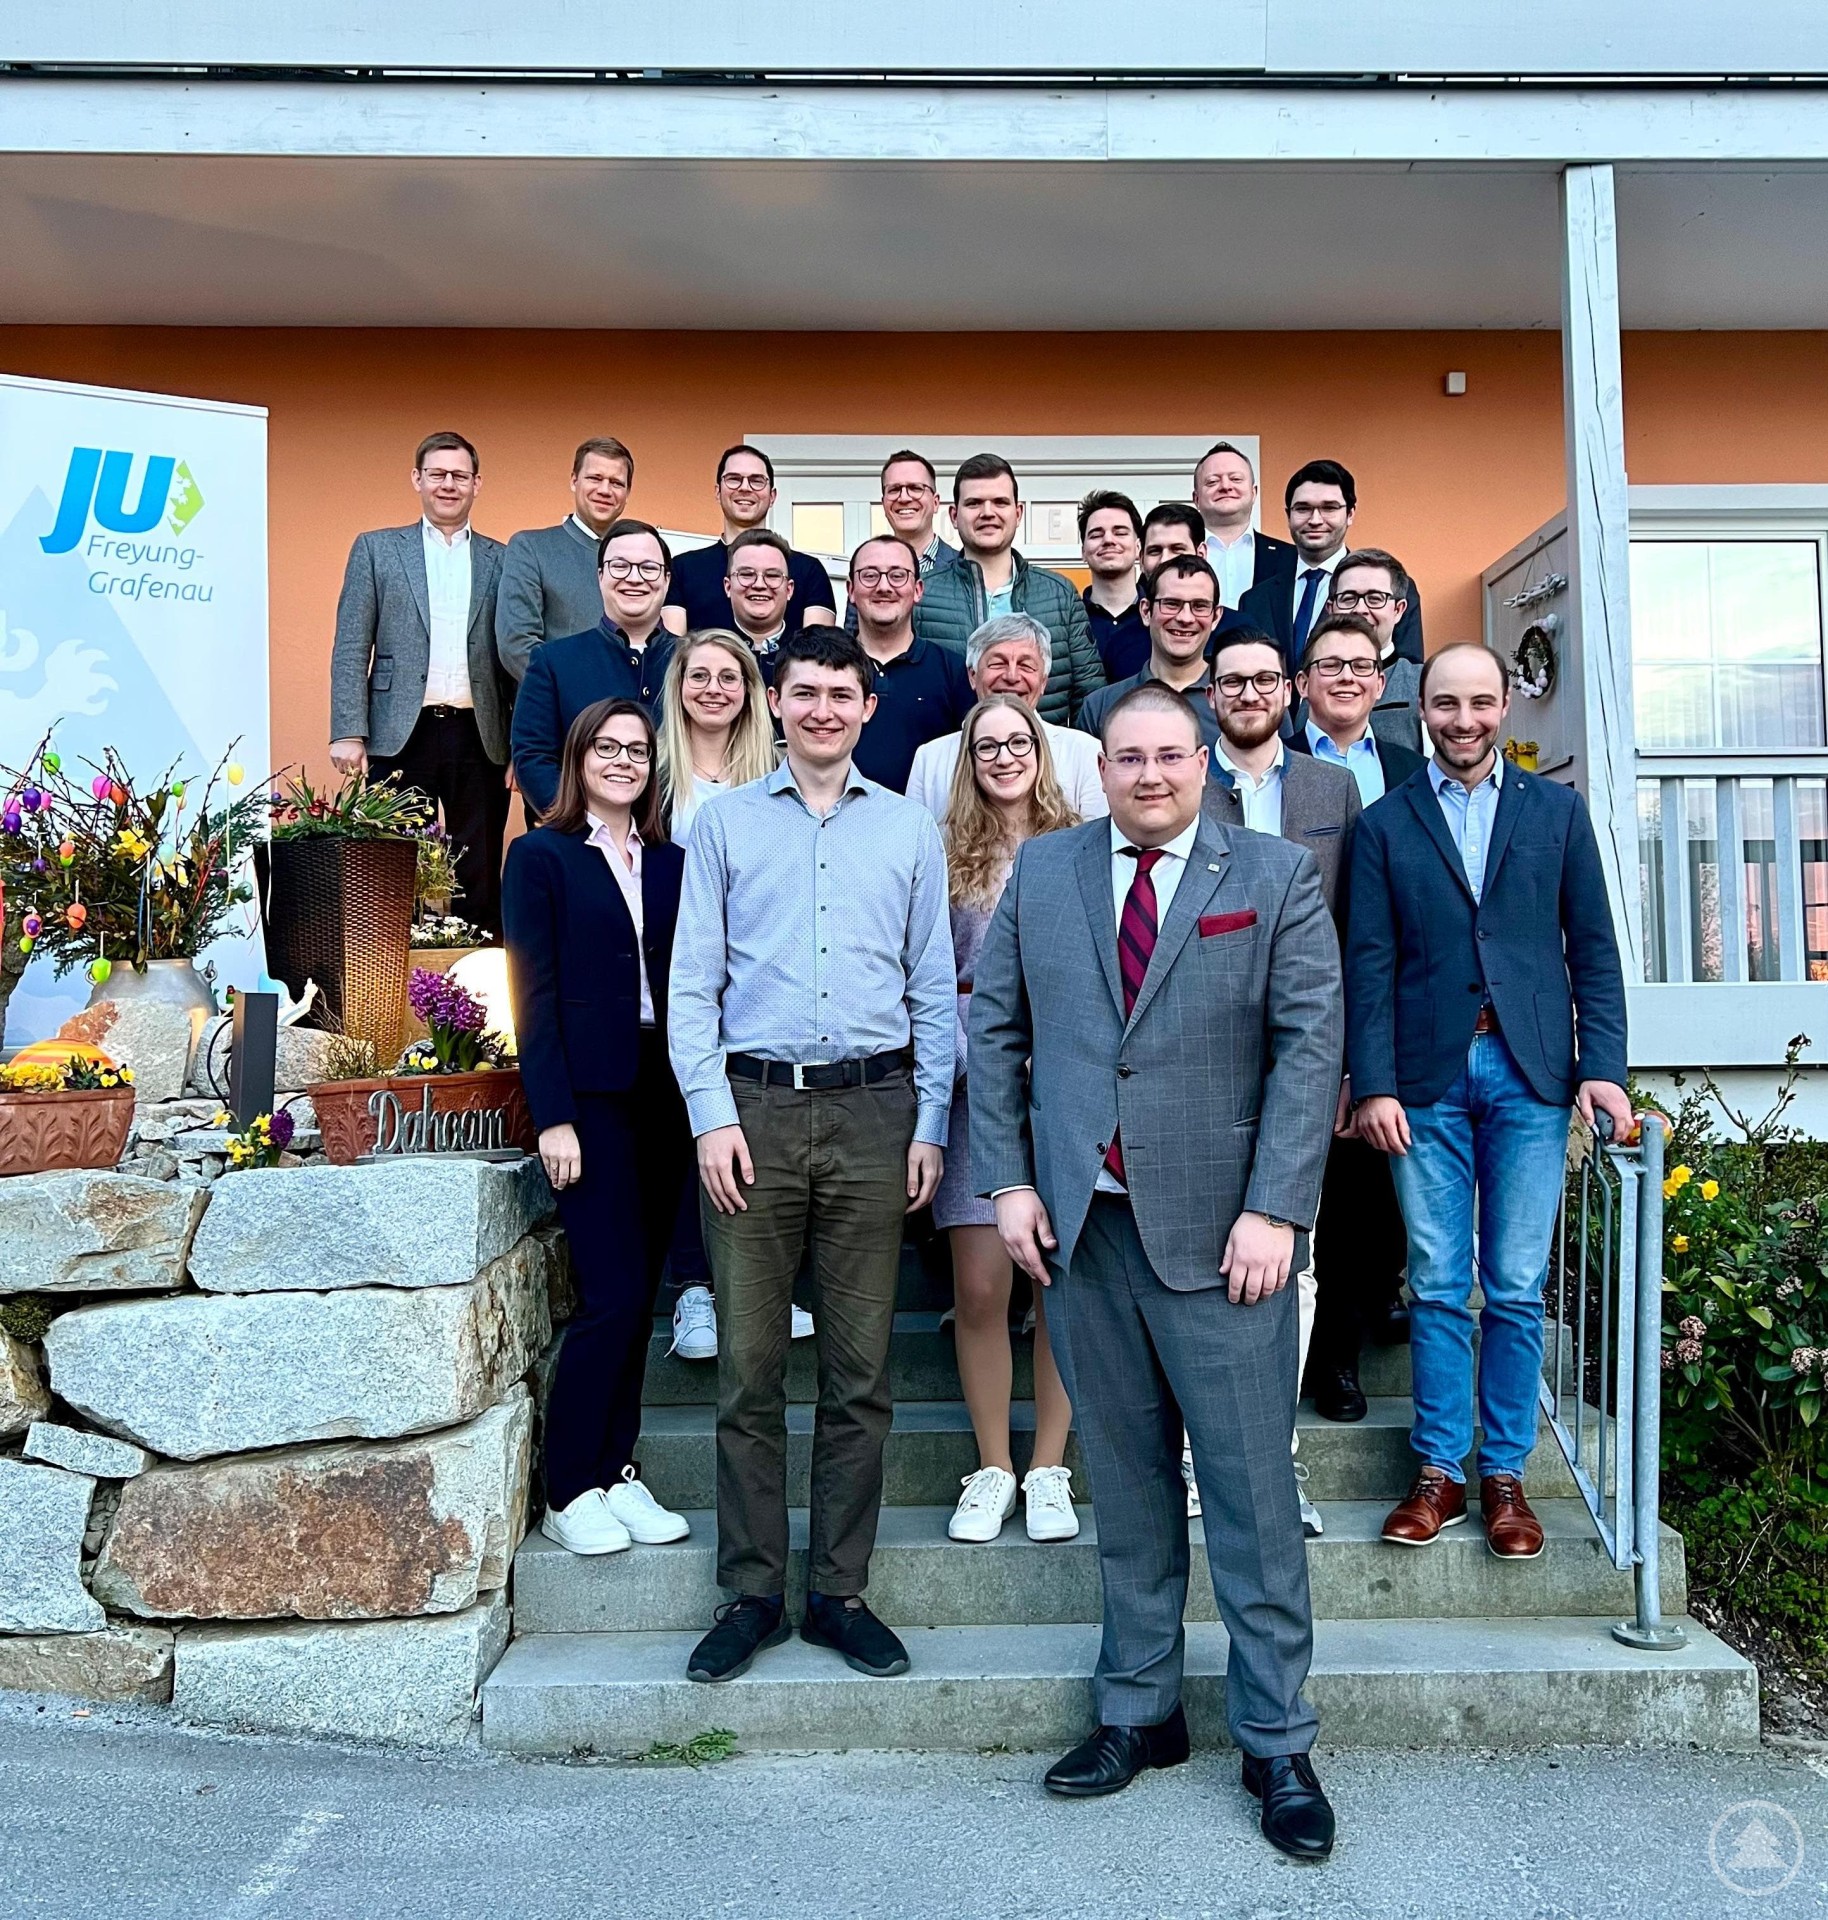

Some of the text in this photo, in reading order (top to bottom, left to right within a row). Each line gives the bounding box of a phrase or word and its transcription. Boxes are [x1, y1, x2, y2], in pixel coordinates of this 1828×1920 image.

[38, 446, 176, 554] JU
[86, 534, 205, 570] Freyung-
[88, 571, 213, 602] Grafenau
[368, 1083, 506, 1154] Dahoam
